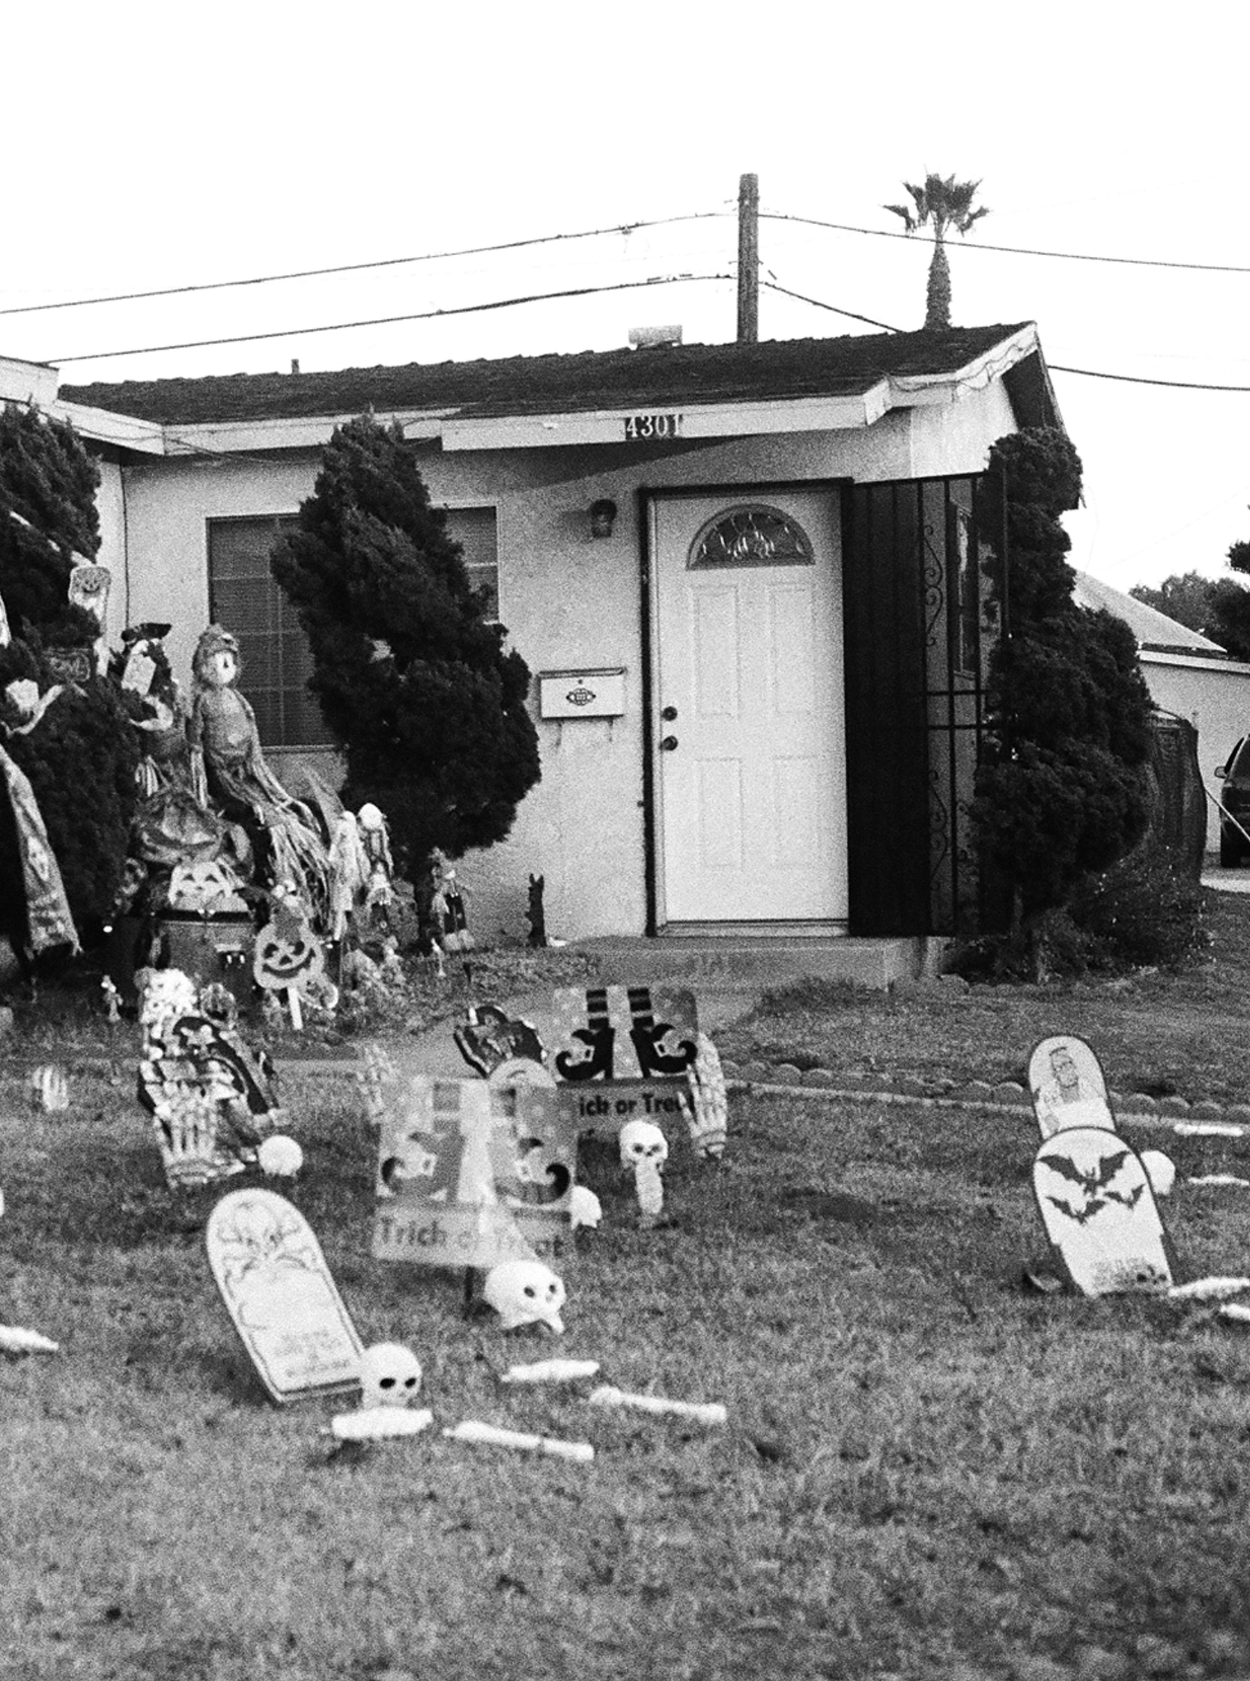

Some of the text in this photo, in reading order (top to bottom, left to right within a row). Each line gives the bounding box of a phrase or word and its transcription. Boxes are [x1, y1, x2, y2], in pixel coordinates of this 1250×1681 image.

[627, 413, 681, 438] 4301
[579, 1092, 684, 1116] ick or Tre
